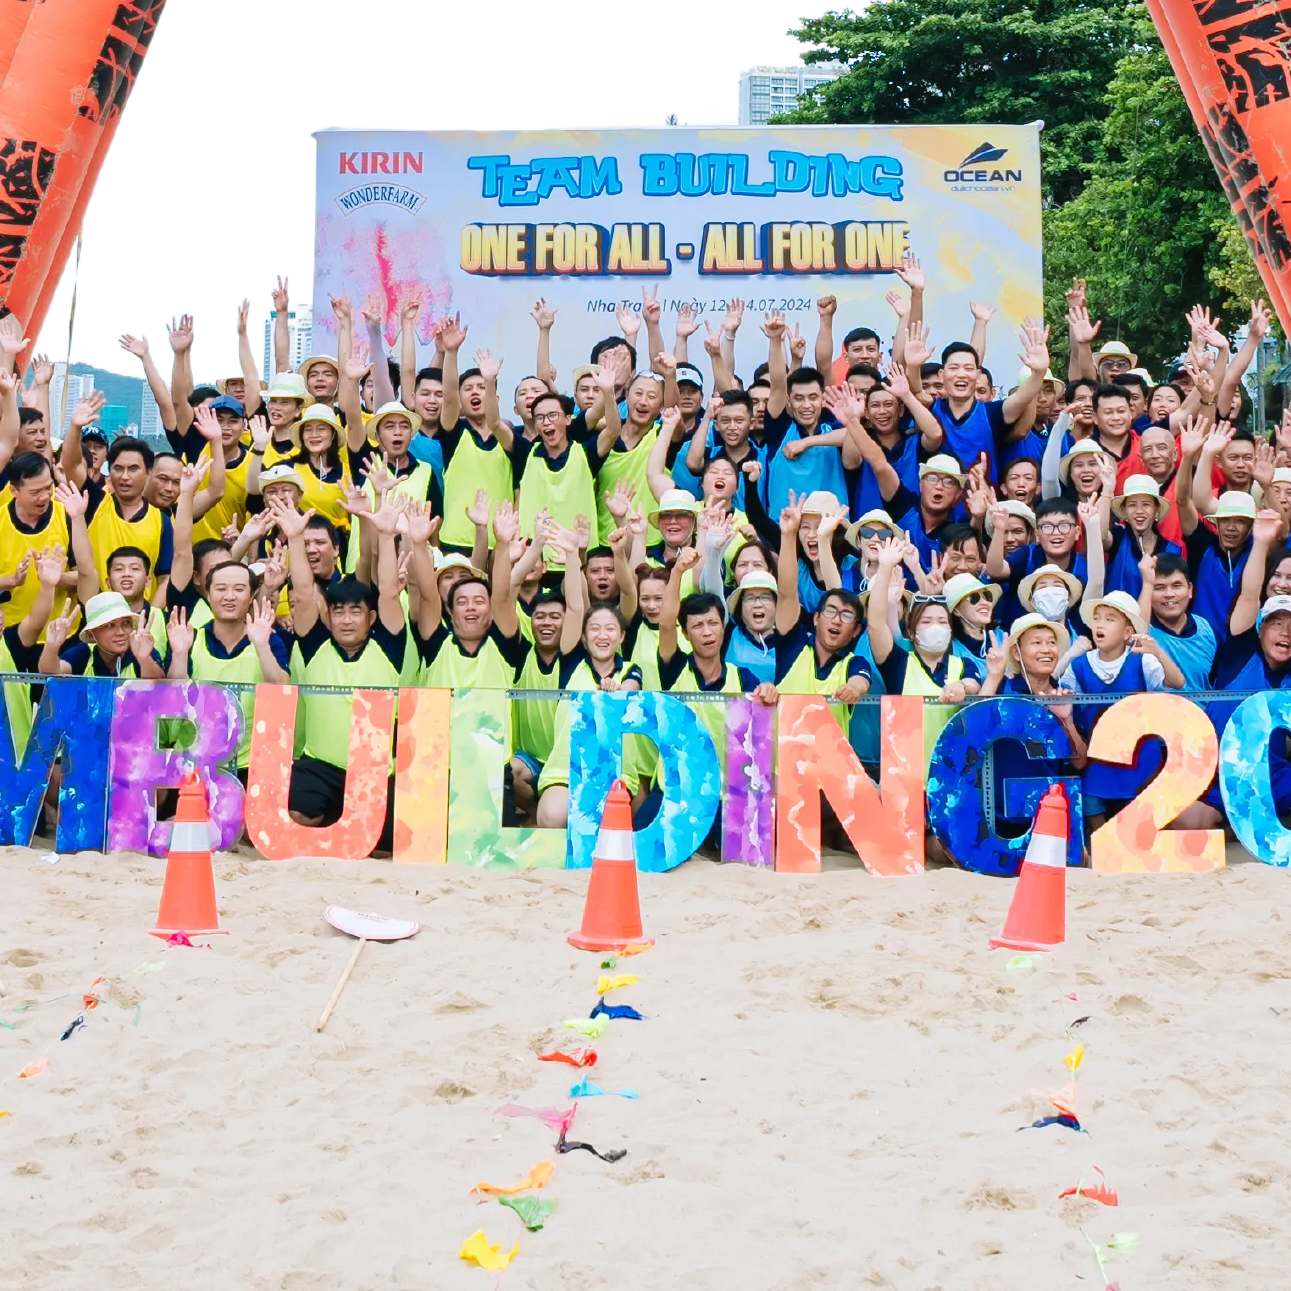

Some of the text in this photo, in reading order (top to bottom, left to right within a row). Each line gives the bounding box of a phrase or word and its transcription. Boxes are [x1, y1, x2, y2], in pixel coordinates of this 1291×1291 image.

[338, 151, 424, 175] KIRIN
[467, 150, 904, 207] TEAM BUILDING
[944, 169, 1022, 183] OCEAN
[340, 185, 420, 210] WONDERFARM
[460, 222, 530, 276] ONE
[534, 222, 602, 276] FOR
[606, 222, 672, 276] ALL
[698, 221, 766, 275] ALL
[769, 221, 837, 275] FOR
[843, 221, 911, 273] ONE
[587, 299, 615, 312] Nha
[741, 298, 812, 312] 4.07.2024
